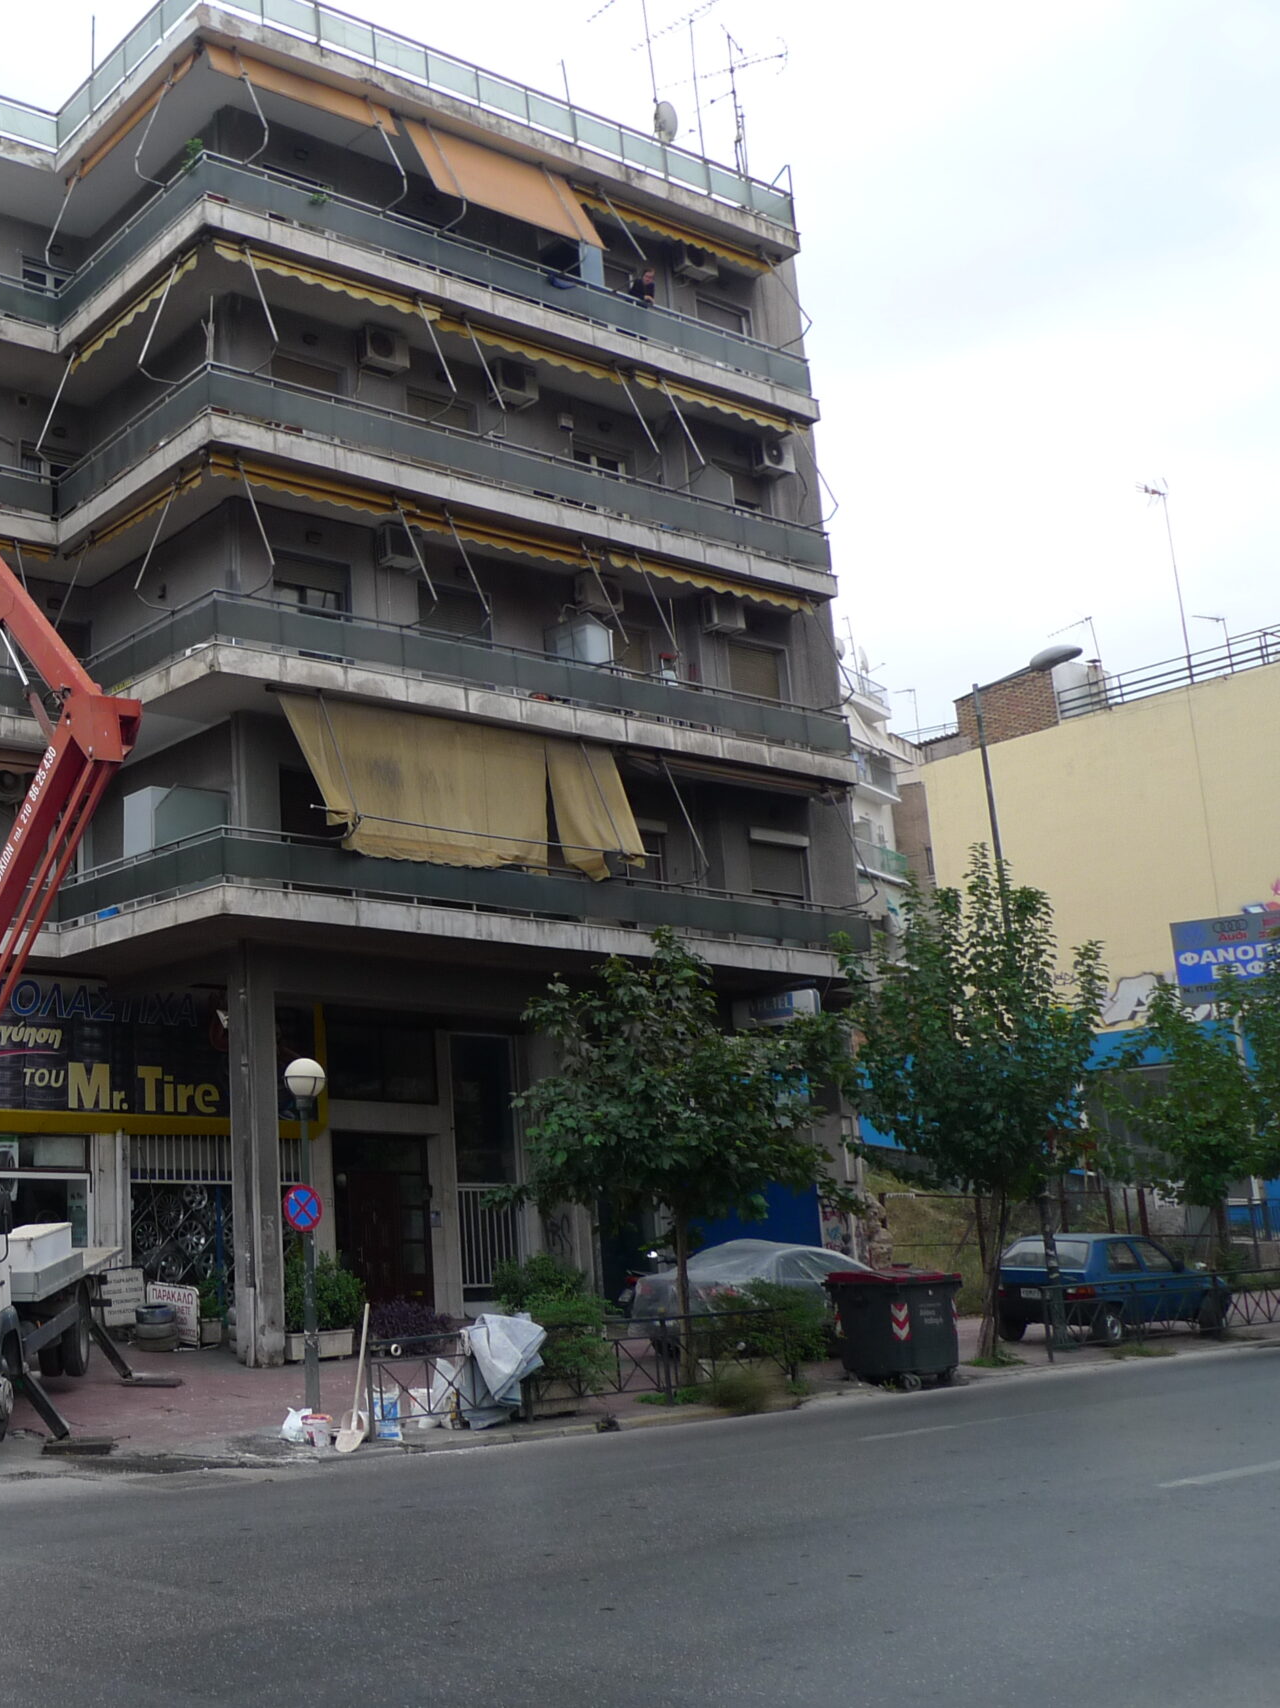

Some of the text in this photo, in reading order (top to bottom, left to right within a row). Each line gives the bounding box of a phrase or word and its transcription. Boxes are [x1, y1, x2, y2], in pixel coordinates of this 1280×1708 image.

[20, 802, 33, 825] 210
[28, 746, 57, 802] 86.25.430
[1218, 931, 1248, 942] Audi
[68, 1062, 128, 1111] Mr.
[137, 1065, 220, 1114] Tire
[152, 1288, 194, 1305] ΠΑΡΑΚΑΛΩ
